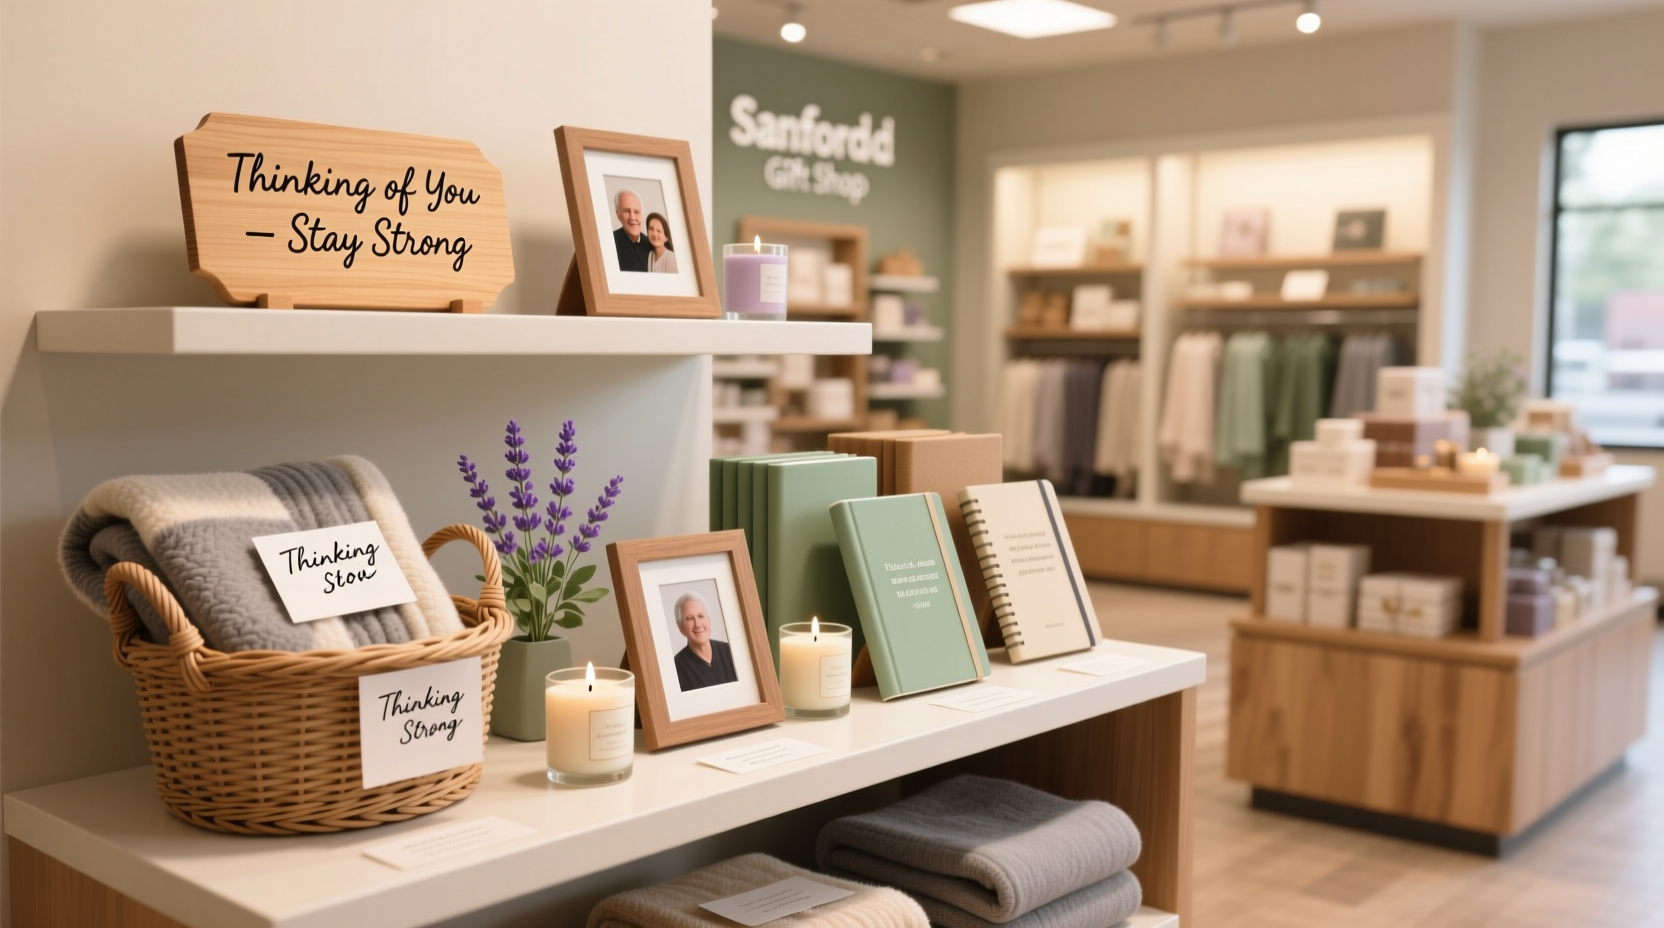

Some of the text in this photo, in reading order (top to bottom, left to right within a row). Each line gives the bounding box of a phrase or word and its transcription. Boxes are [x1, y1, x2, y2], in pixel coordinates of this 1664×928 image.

[729, 94, 895, 167] Sanfordd
[227, 152, 481, 216] Thinking of You
[812, 160, 870, 206] Shop
[288, 212, 363, 269] Stay
[372, 217, 473, 272] Strong
[279, 541, 379, 575] Thinking
[378, 686, 465, 721] Thinking
[400, 719, 463, 744] Strong
